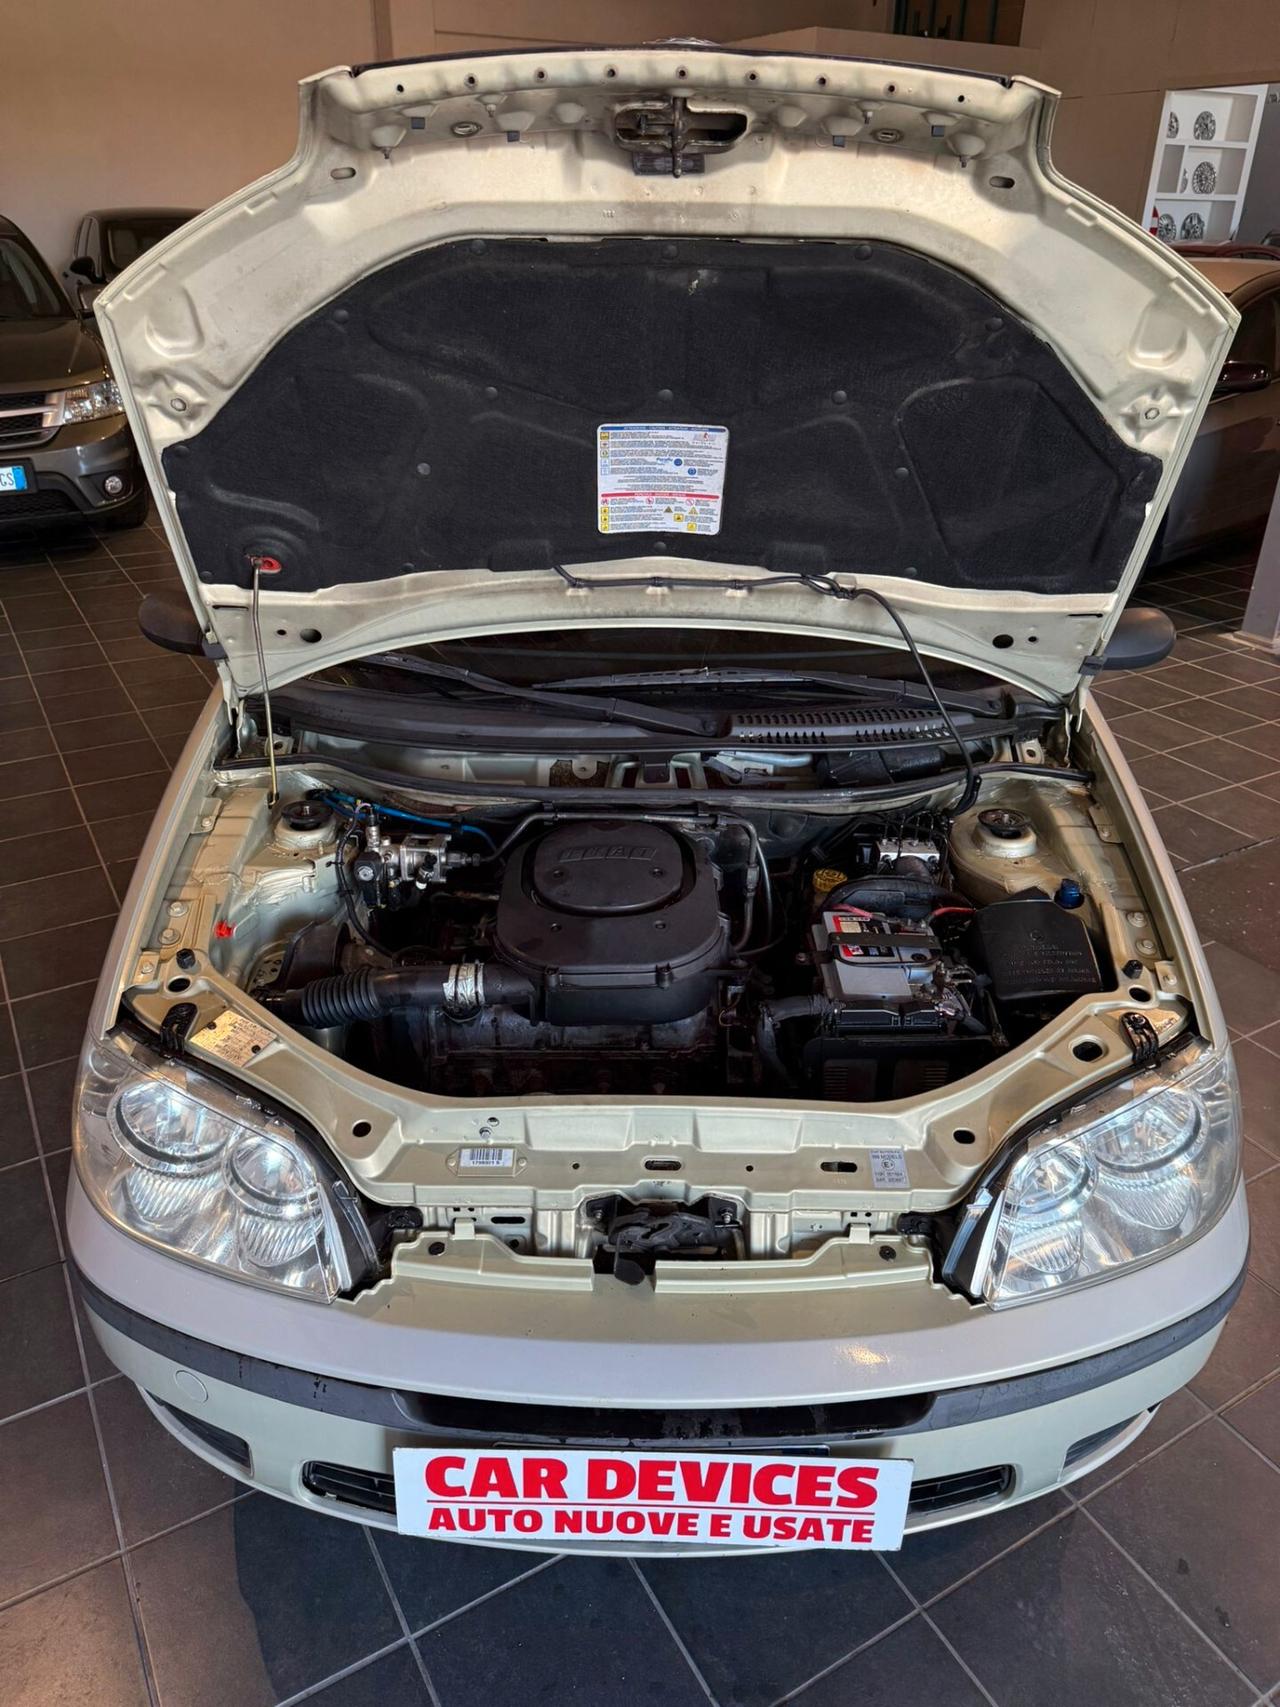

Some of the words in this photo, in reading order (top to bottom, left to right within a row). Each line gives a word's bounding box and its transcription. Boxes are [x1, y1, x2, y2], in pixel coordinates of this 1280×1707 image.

[425, 1456, 568, 1499] CAR
[587, 1459, 879, 1509] DEVICES
[428, 1507, 543, 1533] AUTO
[554, 1510, 699, 1536] NUOVE
[710, 1514, 732, 1537] E
[743, 1515, 875, 1543] USATE
